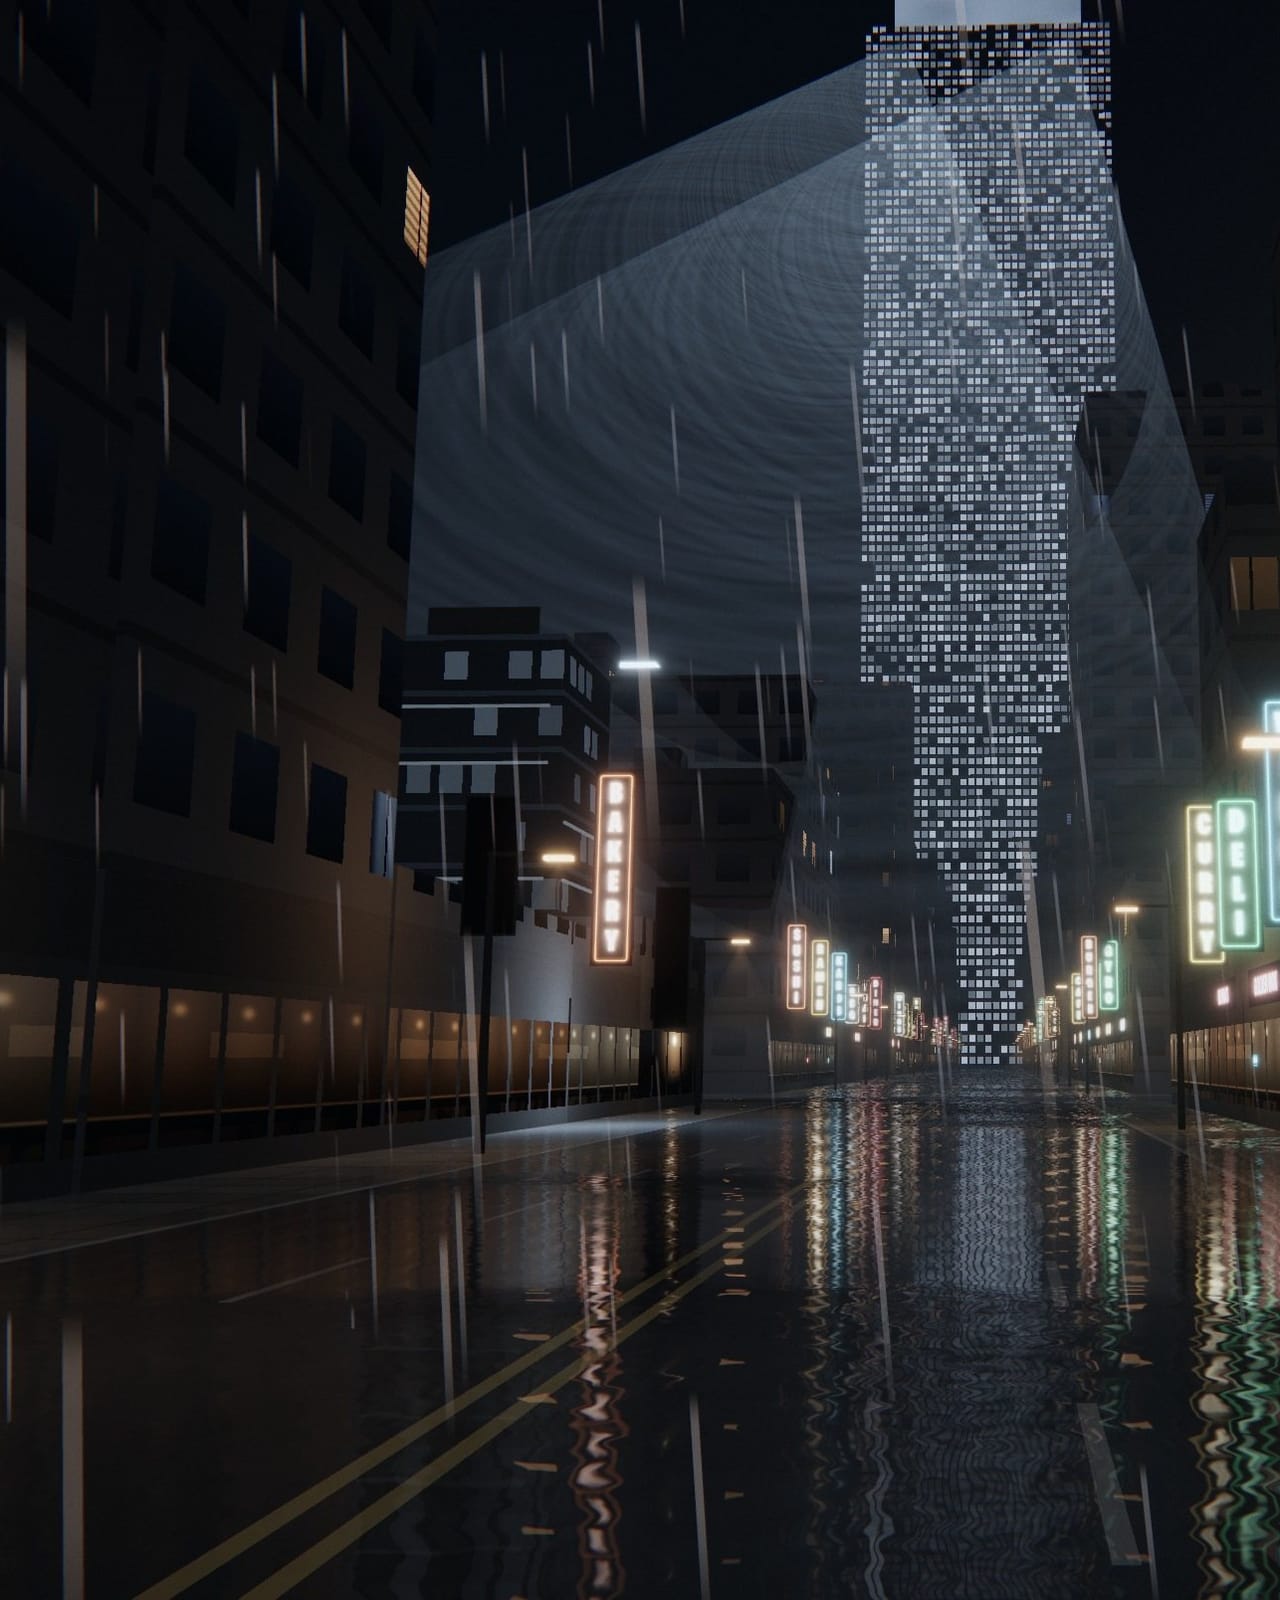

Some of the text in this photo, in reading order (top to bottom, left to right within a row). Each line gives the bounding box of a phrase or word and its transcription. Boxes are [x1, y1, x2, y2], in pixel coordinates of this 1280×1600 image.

[604, 780, 625, 953] BAKERY
[1194, 810, 1215, 954] CURRY
[1227, 806, 1247, 938] DELI
[791, 927, 803, 1006] SUSHI
